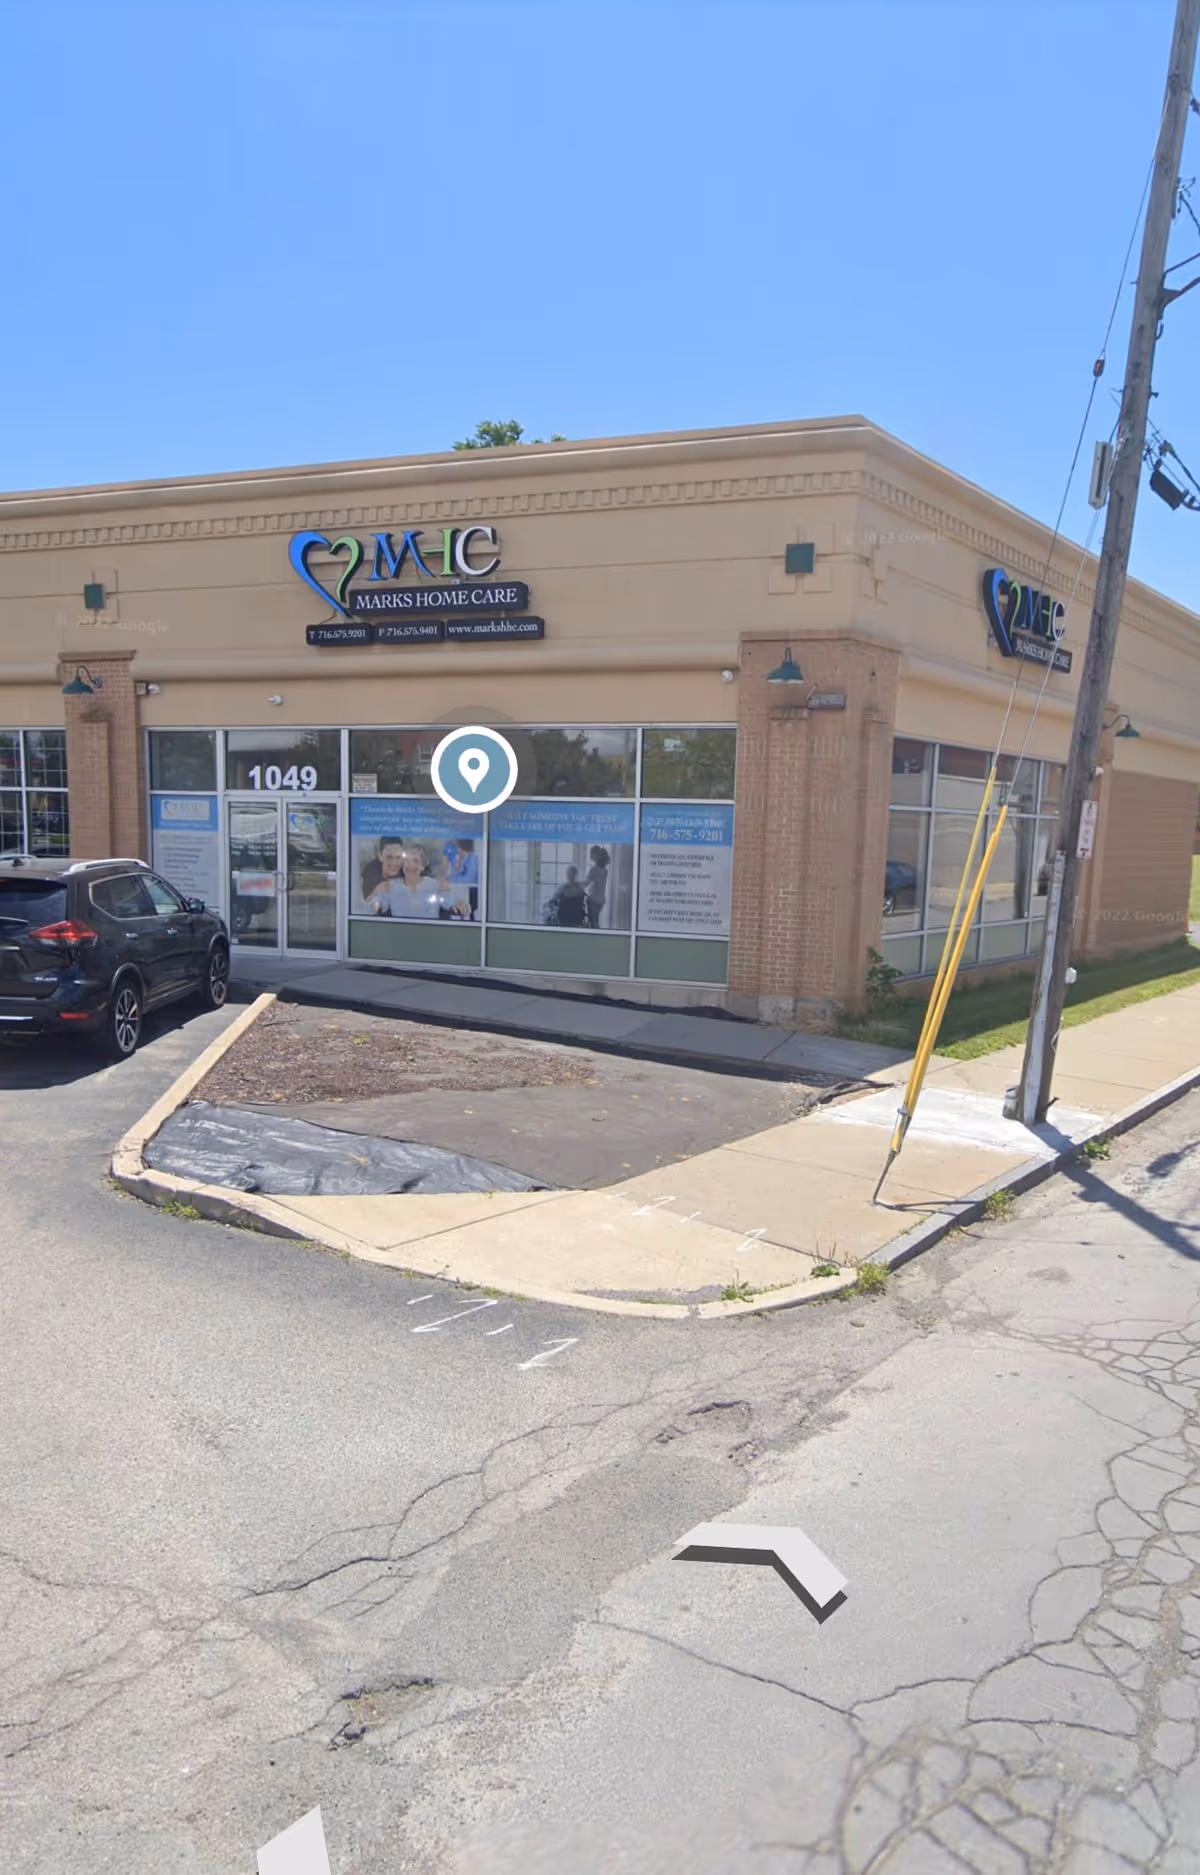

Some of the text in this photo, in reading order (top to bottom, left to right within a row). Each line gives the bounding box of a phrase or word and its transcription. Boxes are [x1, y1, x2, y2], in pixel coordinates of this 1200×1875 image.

[368, 525, 501, 581] MHC
[356, 588, 518, 610] MARKS HOME CARE
[318, 629, 366, 639] 716.575.9201
[386, 626, 438, 637] 716.575.9401
[448, 622, 538, 635] www.markshhc.com
[248, 765, 317, 790] 1049
[650, 828, 723, 841] 716-575-9201
